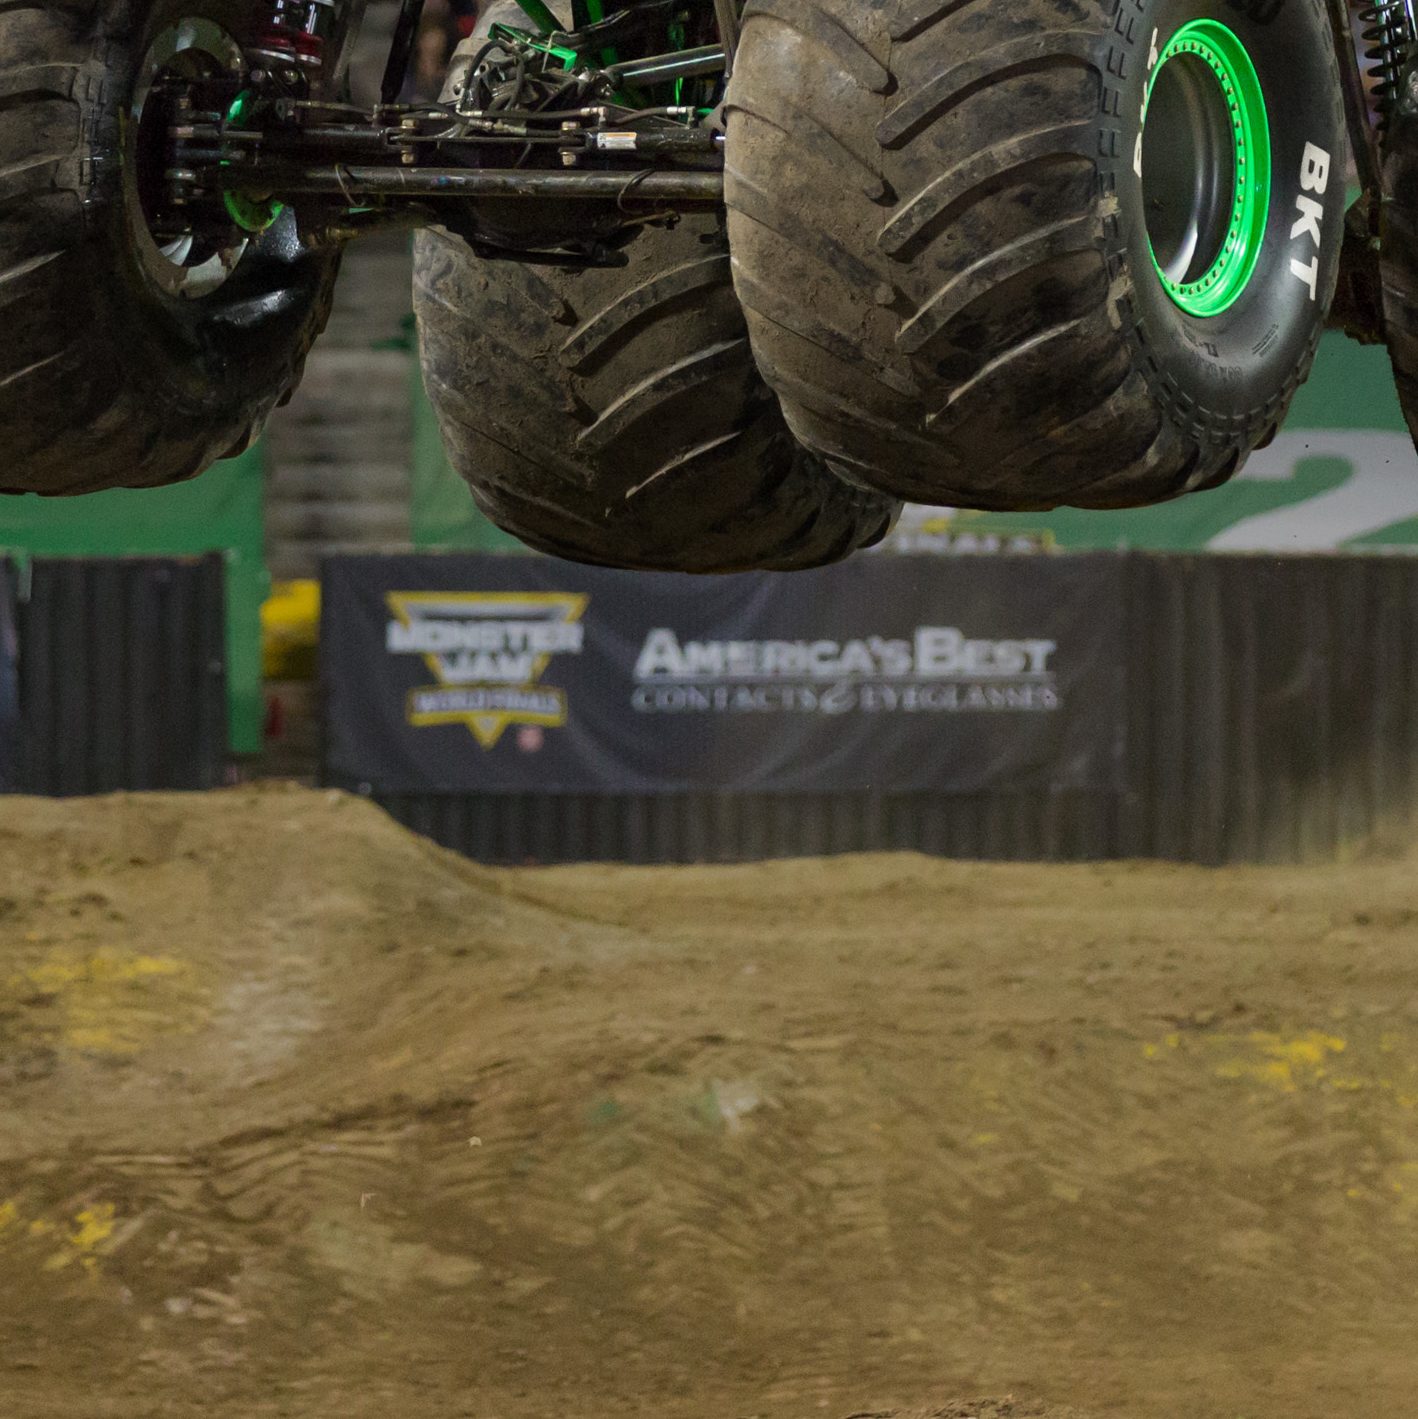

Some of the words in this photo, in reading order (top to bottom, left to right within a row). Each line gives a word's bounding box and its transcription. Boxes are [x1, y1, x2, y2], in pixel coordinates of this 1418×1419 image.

[1289, 140, 1331, 301] BKT
[385, 618, 585, 654] MONSTER
[440, 650, 533, 685] JAM
[630, 683, 819, 713] CONTACTS
[859, 683, 1063, 713] EYEGLASSES
